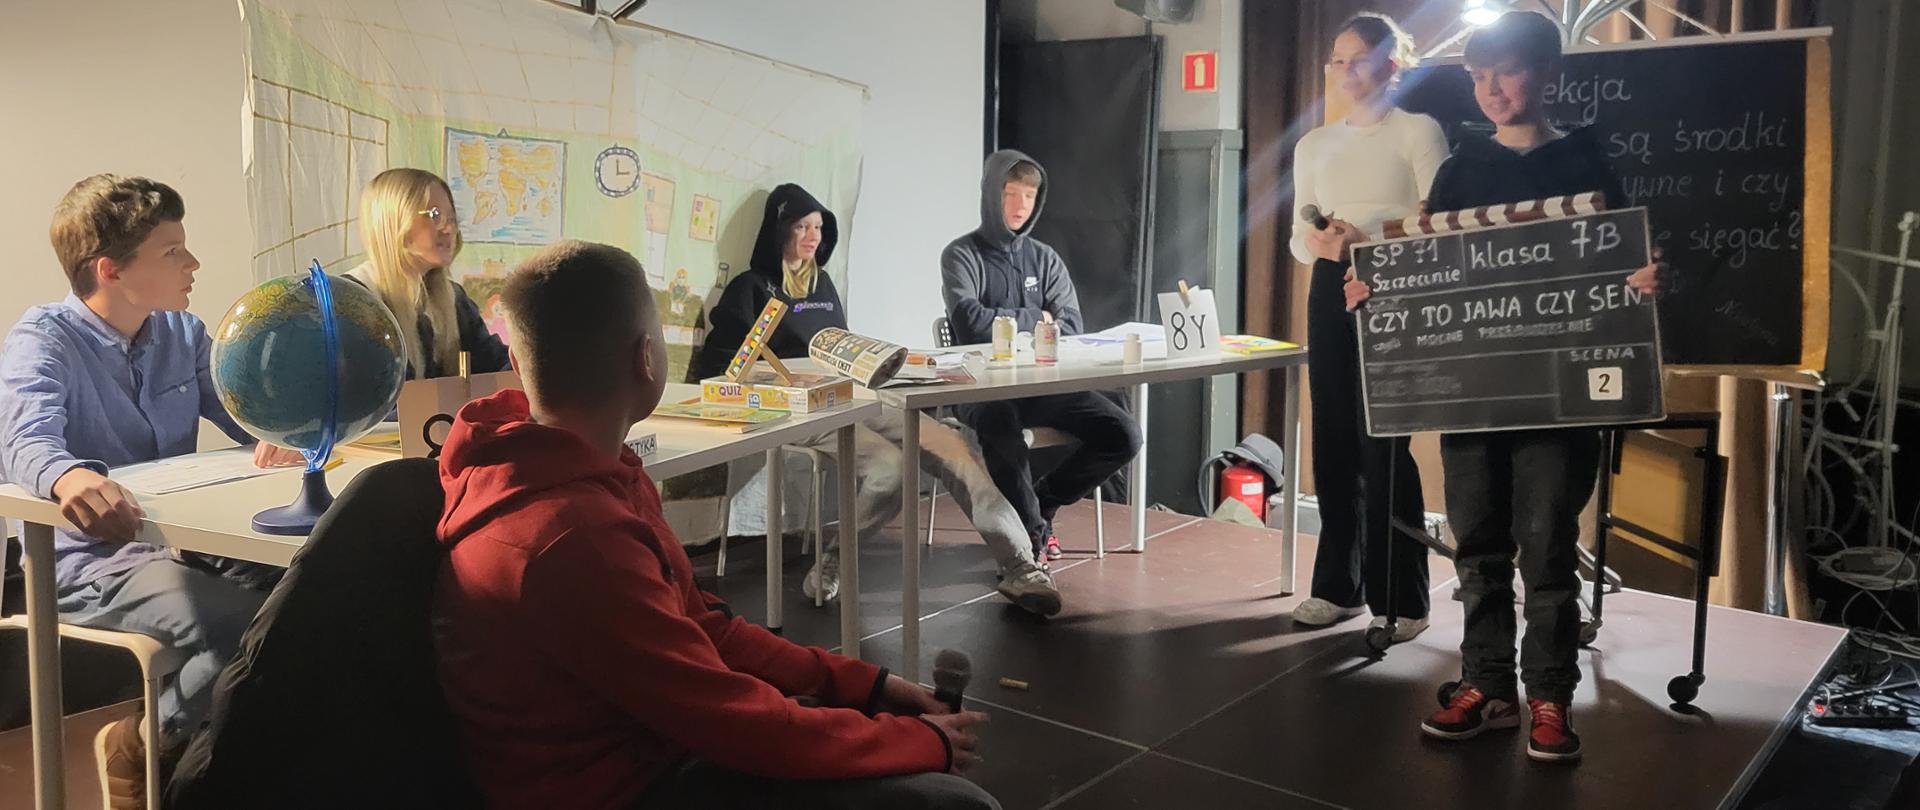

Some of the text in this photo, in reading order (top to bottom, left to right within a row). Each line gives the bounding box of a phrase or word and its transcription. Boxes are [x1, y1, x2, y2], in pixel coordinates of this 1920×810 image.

[1542, 72, 1632, 123] ekcja
[1607, 111, 1788, 165] są środki
[1621, 169, 1790, 212] ywne i czy
[1370, 238, 1440, 268] SP 71
[1470, 240, 1555, 271] klasa
[1367, 311, 1410, 335] CZY
[1421, 303, 1453, 328] TO
[1461, 296, 1523, 324] JAWA
[1534, 288, 1577, 316] CZY
[1587, 284, 1643, 312] SEN
[1170, 311, 1206, 351] 8Y
[1569, 346, 1636, 362] SCENA
[718, 385, 742, 397] QUIZ
[1598, 373, 1612, 394] 2
